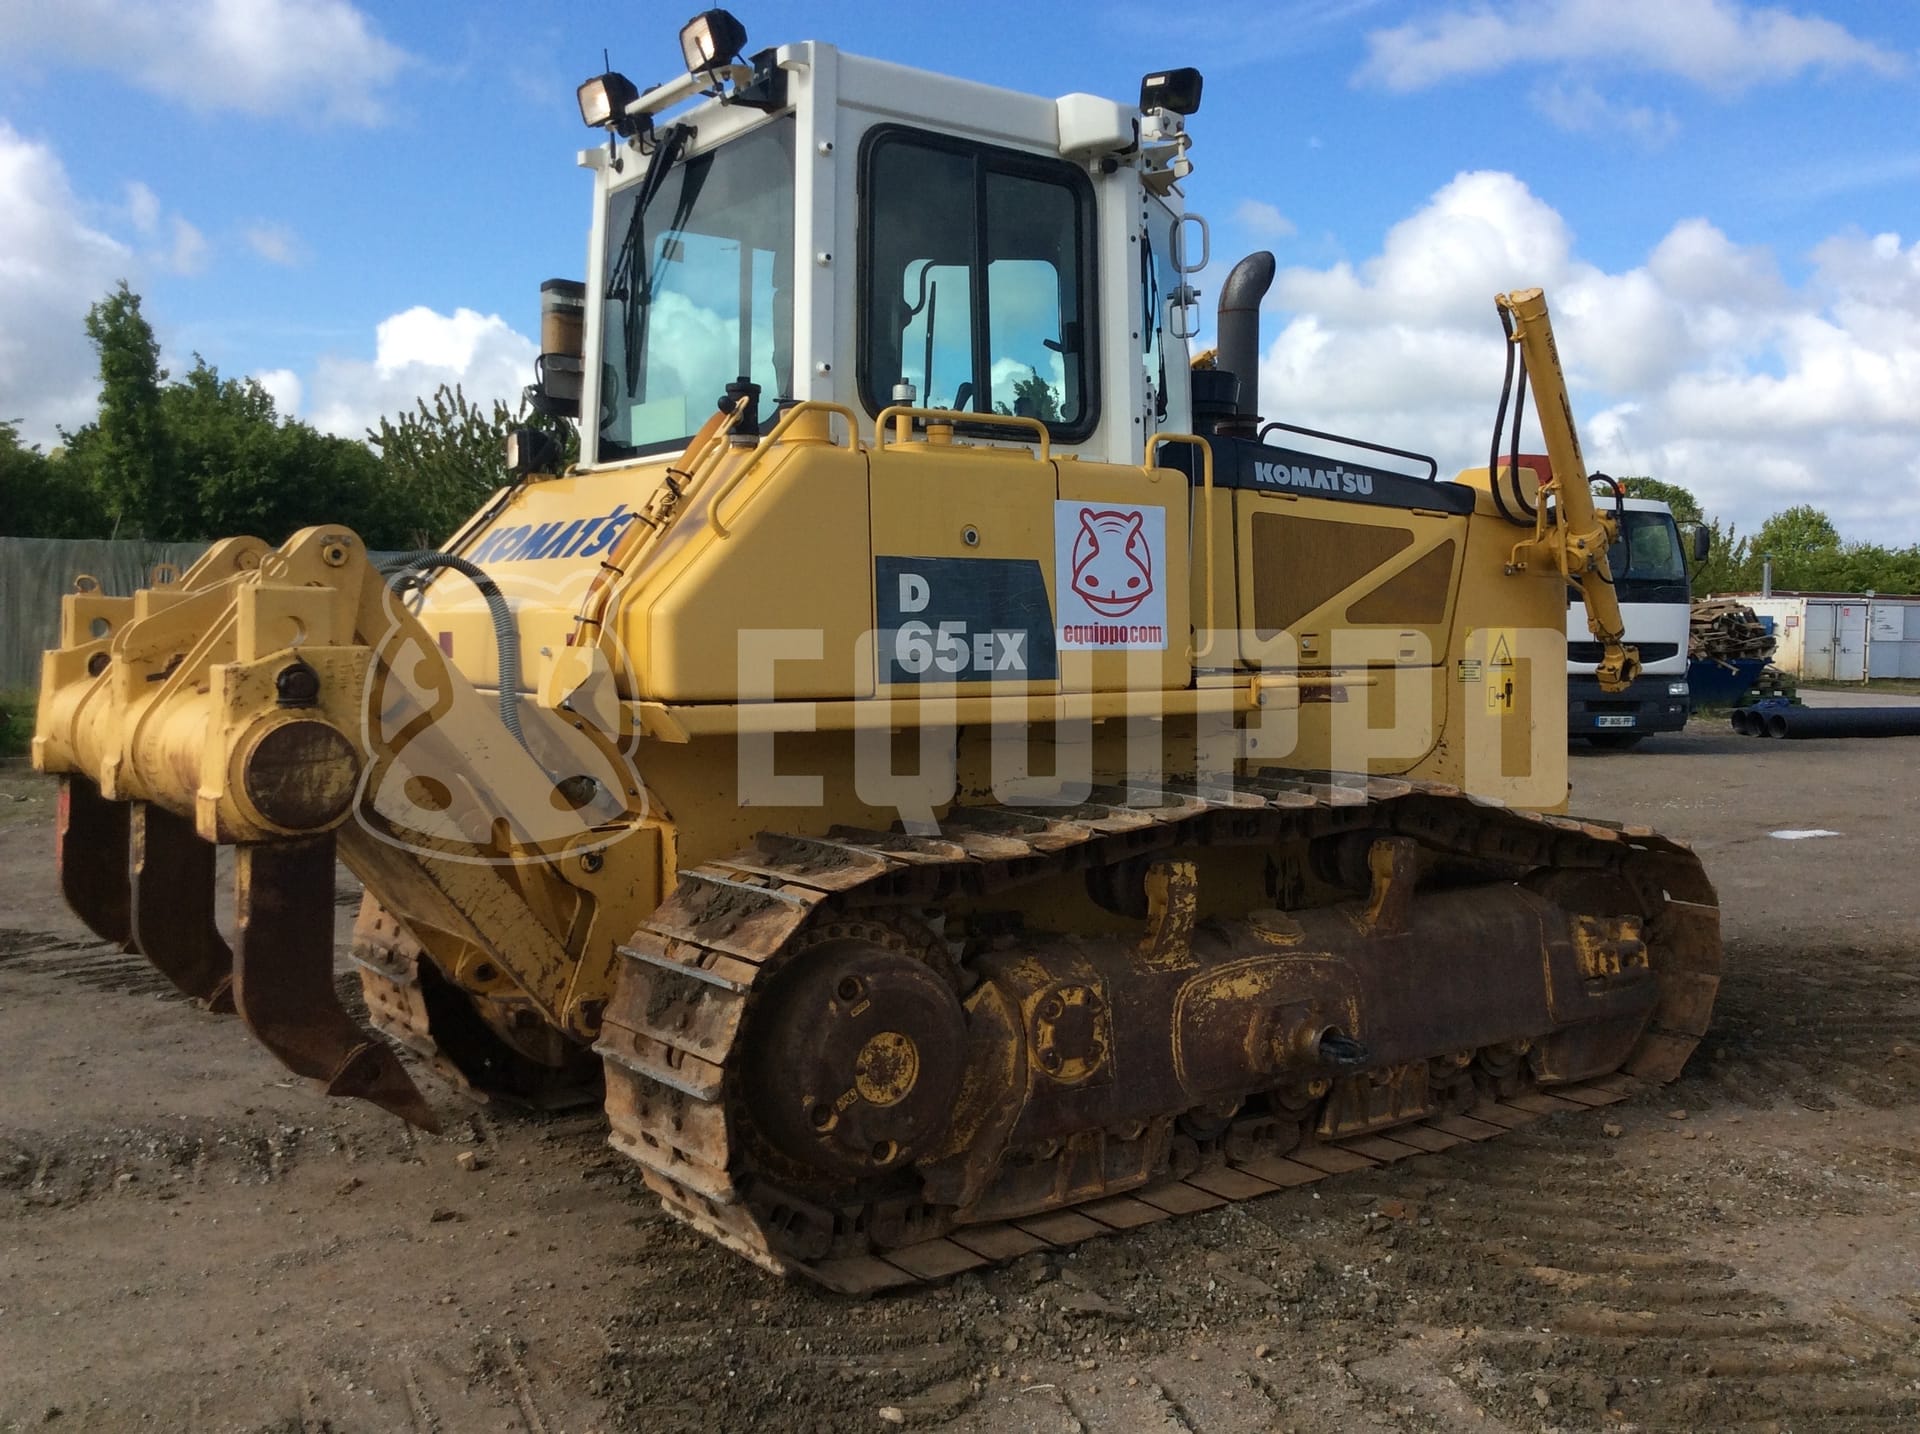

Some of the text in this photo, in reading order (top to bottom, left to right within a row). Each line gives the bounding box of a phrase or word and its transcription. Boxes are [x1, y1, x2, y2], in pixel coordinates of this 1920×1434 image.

[1254, 461, 1374, 495] KOMATSU
[466, 503, 632, 564] KOMATS
[899, 573, 930, 612] D
[1063, 621, 1162, 645] equippo.com
